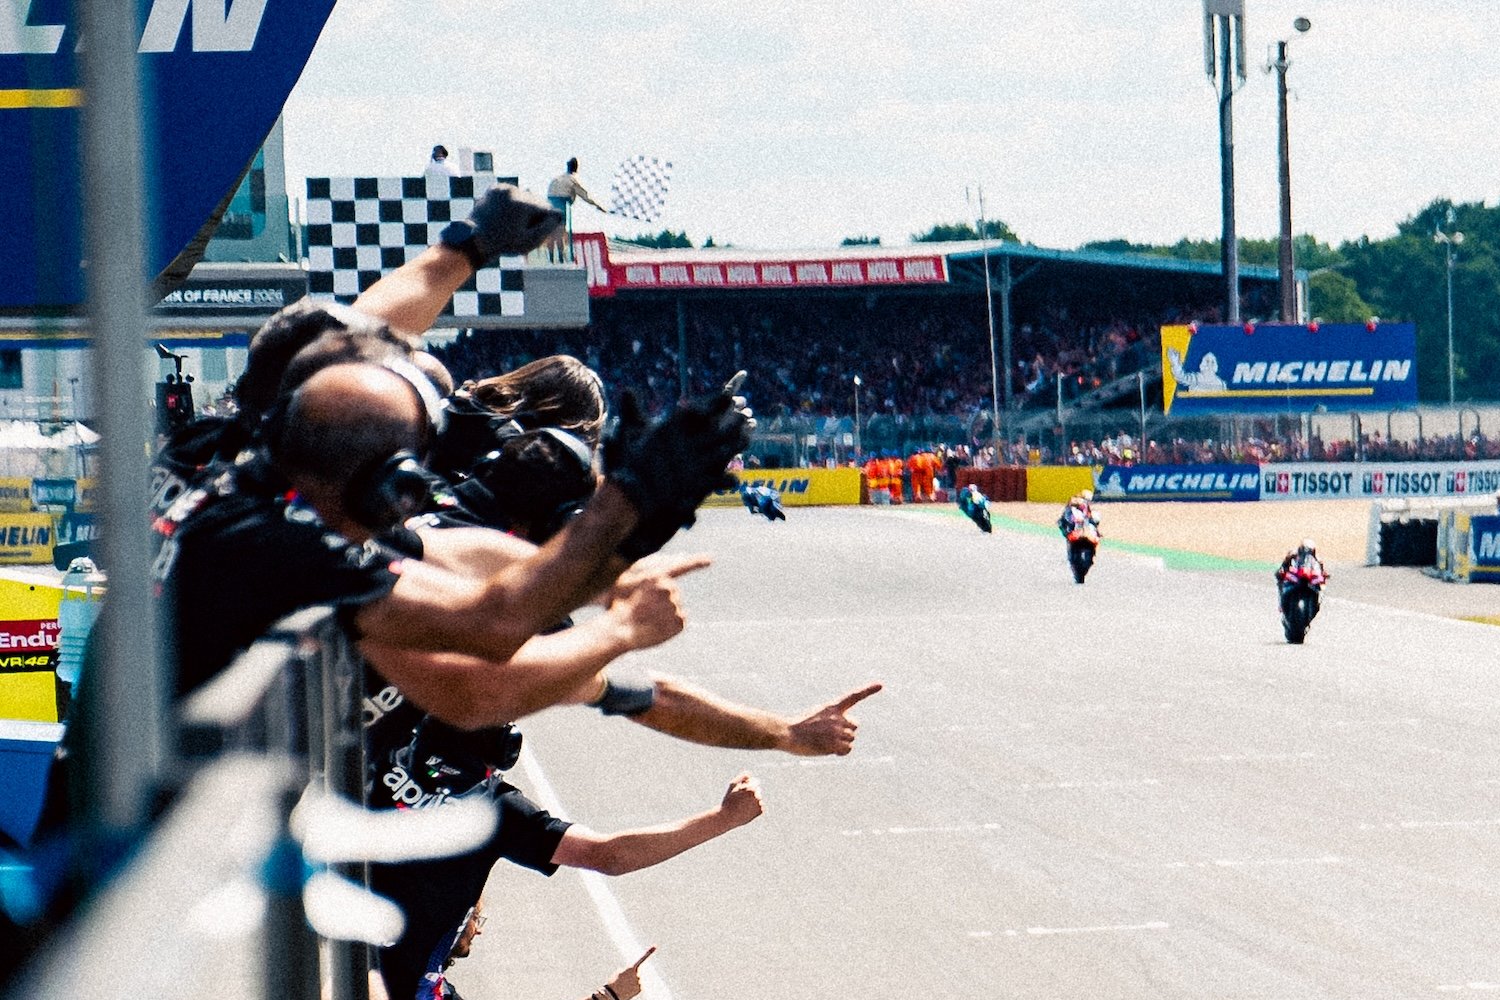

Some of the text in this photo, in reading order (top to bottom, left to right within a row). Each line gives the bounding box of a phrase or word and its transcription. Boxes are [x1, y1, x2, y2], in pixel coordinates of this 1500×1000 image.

[1232, 360, 1411, 383] MICHELIN
[1128, 472, 1259, 490] MICHELIN
[1291, 472, 1352, 494] TISSOT
[1386, 472, 1440, 494] TISSOT
